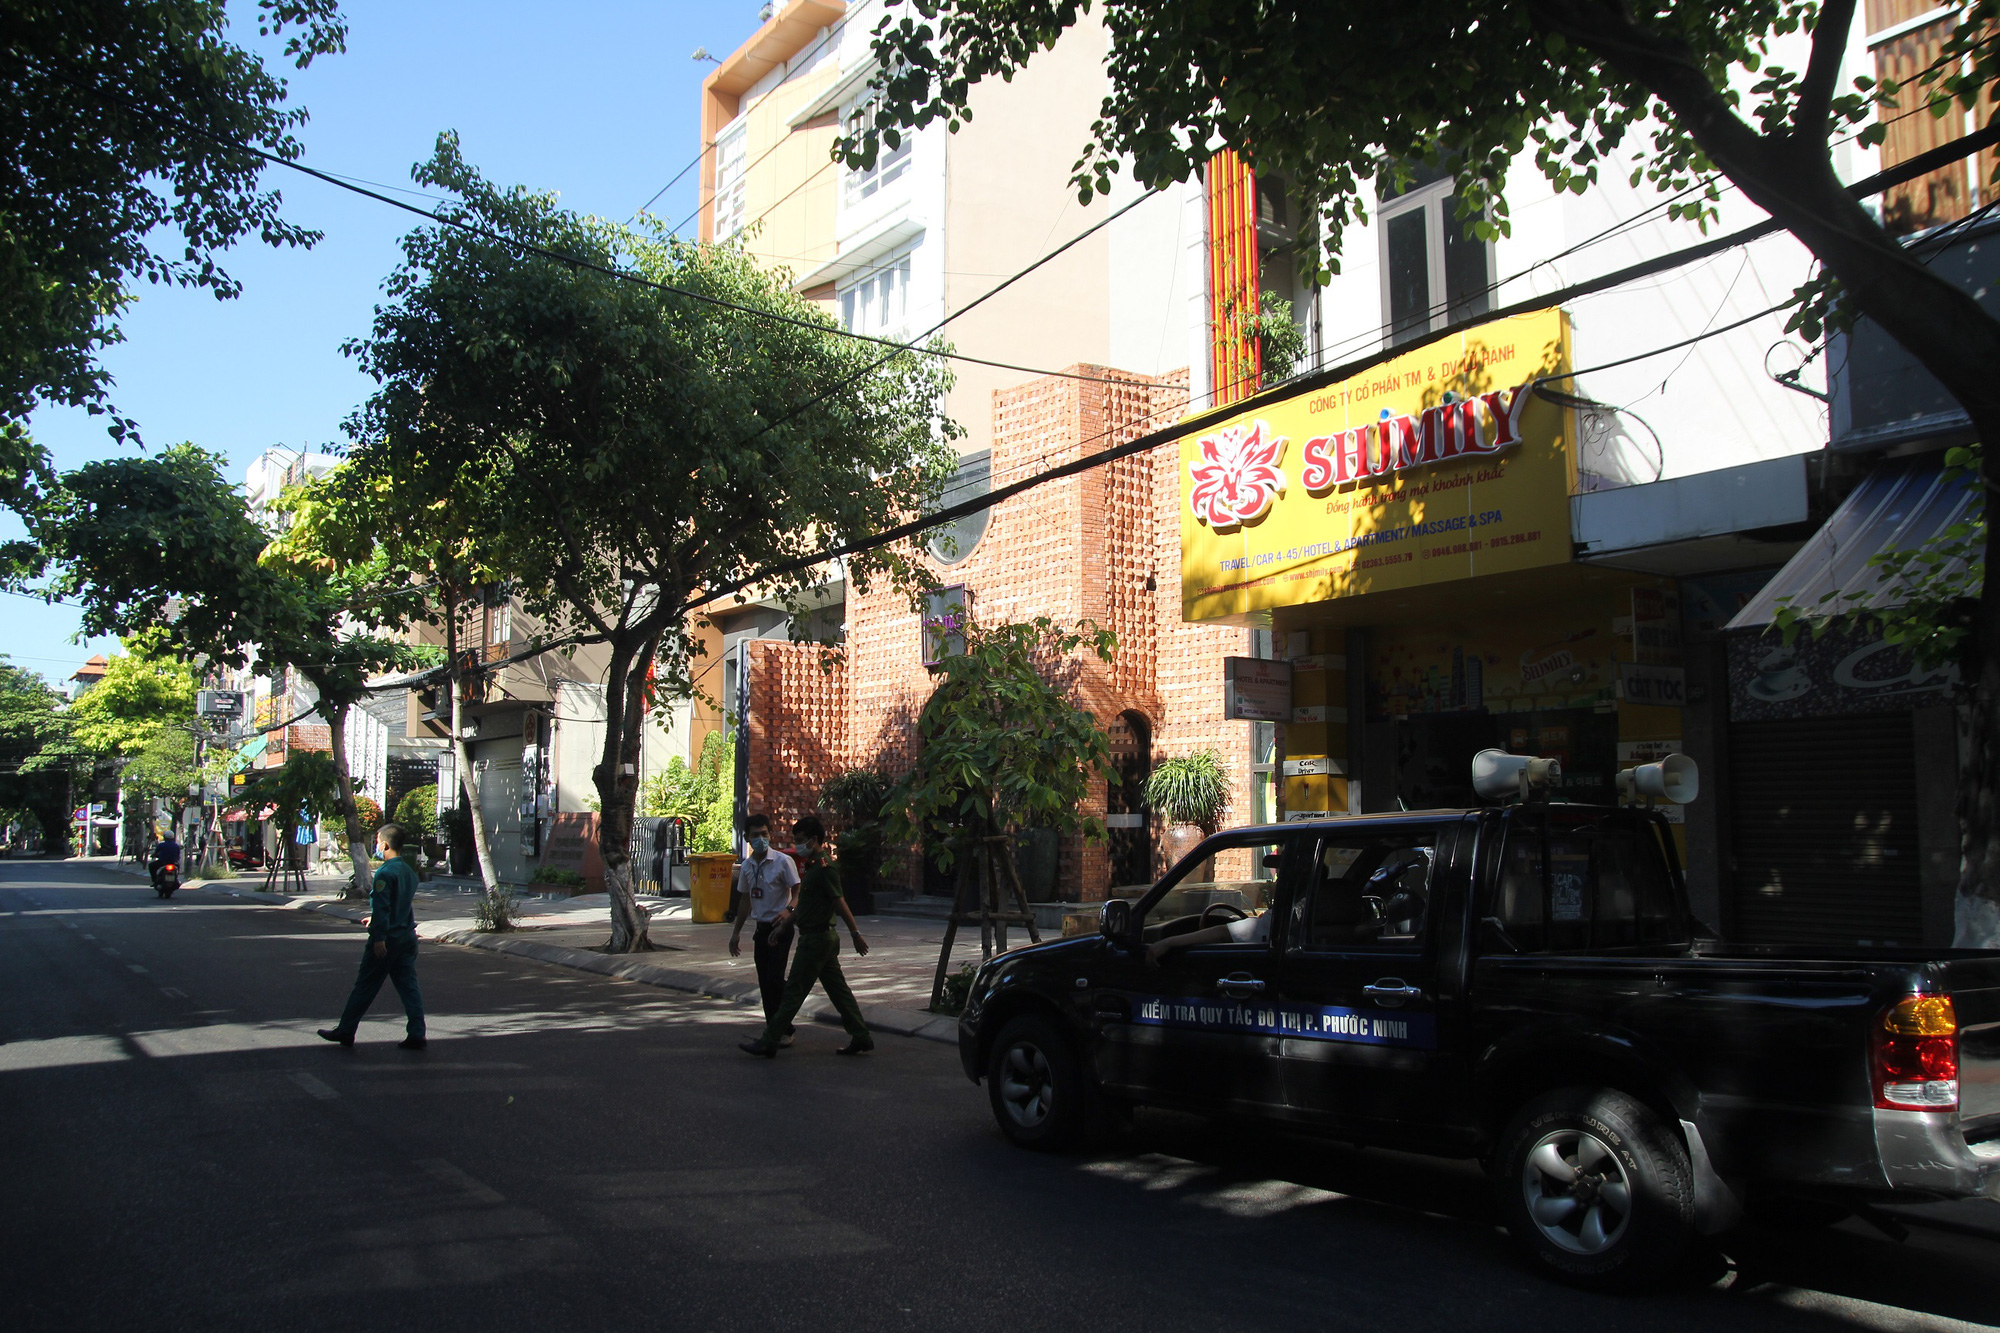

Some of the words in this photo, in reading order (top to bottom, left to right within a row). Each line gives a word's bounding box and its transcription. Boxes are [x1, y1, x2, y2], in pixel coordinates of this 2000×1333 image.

[1309, 395, 1336, 415] CÔNG
[1339, 391, 1353, 407] TY
[1355, 379, 1370, 402] CỔ
[1404, 370, 1422, 388] TM
[1427, 366, 1436, 381] &
[1441, 359, 1459, 378] DV
[1326, 498, 1350, 515] Đồng
[1352, 494, 1378, 510] hành
[1380, 488, 1407, 504] trong
[1409, 484, 1430, 499] mọi
[1432, 473, 1474, 492] khoảnh
[1476, 462, 1505, 484] khắc
[1334, 540, 1342, 552] &
[1468, 513, 1477, 527] &
[1479, 509, 1503, 525] SPA
[1236, 676, 1254, 684] HOTEL
[1259, 678, 1290, 688] APARTMENT
[1655, 675, 1683, 701] TÓC
[1141, 999, 1171, 1020] KIỂM
[1174, 1005, 1196, 1022] TRA
[1200, 1007, 1223, 1025] QUY
[1227, 1004, 1252, 1026] TẮC
[1258, 1006, 1275, 1027] ĐÔ
[1280, 1011, 1301, 1033] THỊ
[1305, 1014, 1318, 1031] P.
[1322, 1013, 1369, 1036] PHƯỚC
[1373, 1020, 1408, 1040] NINH
